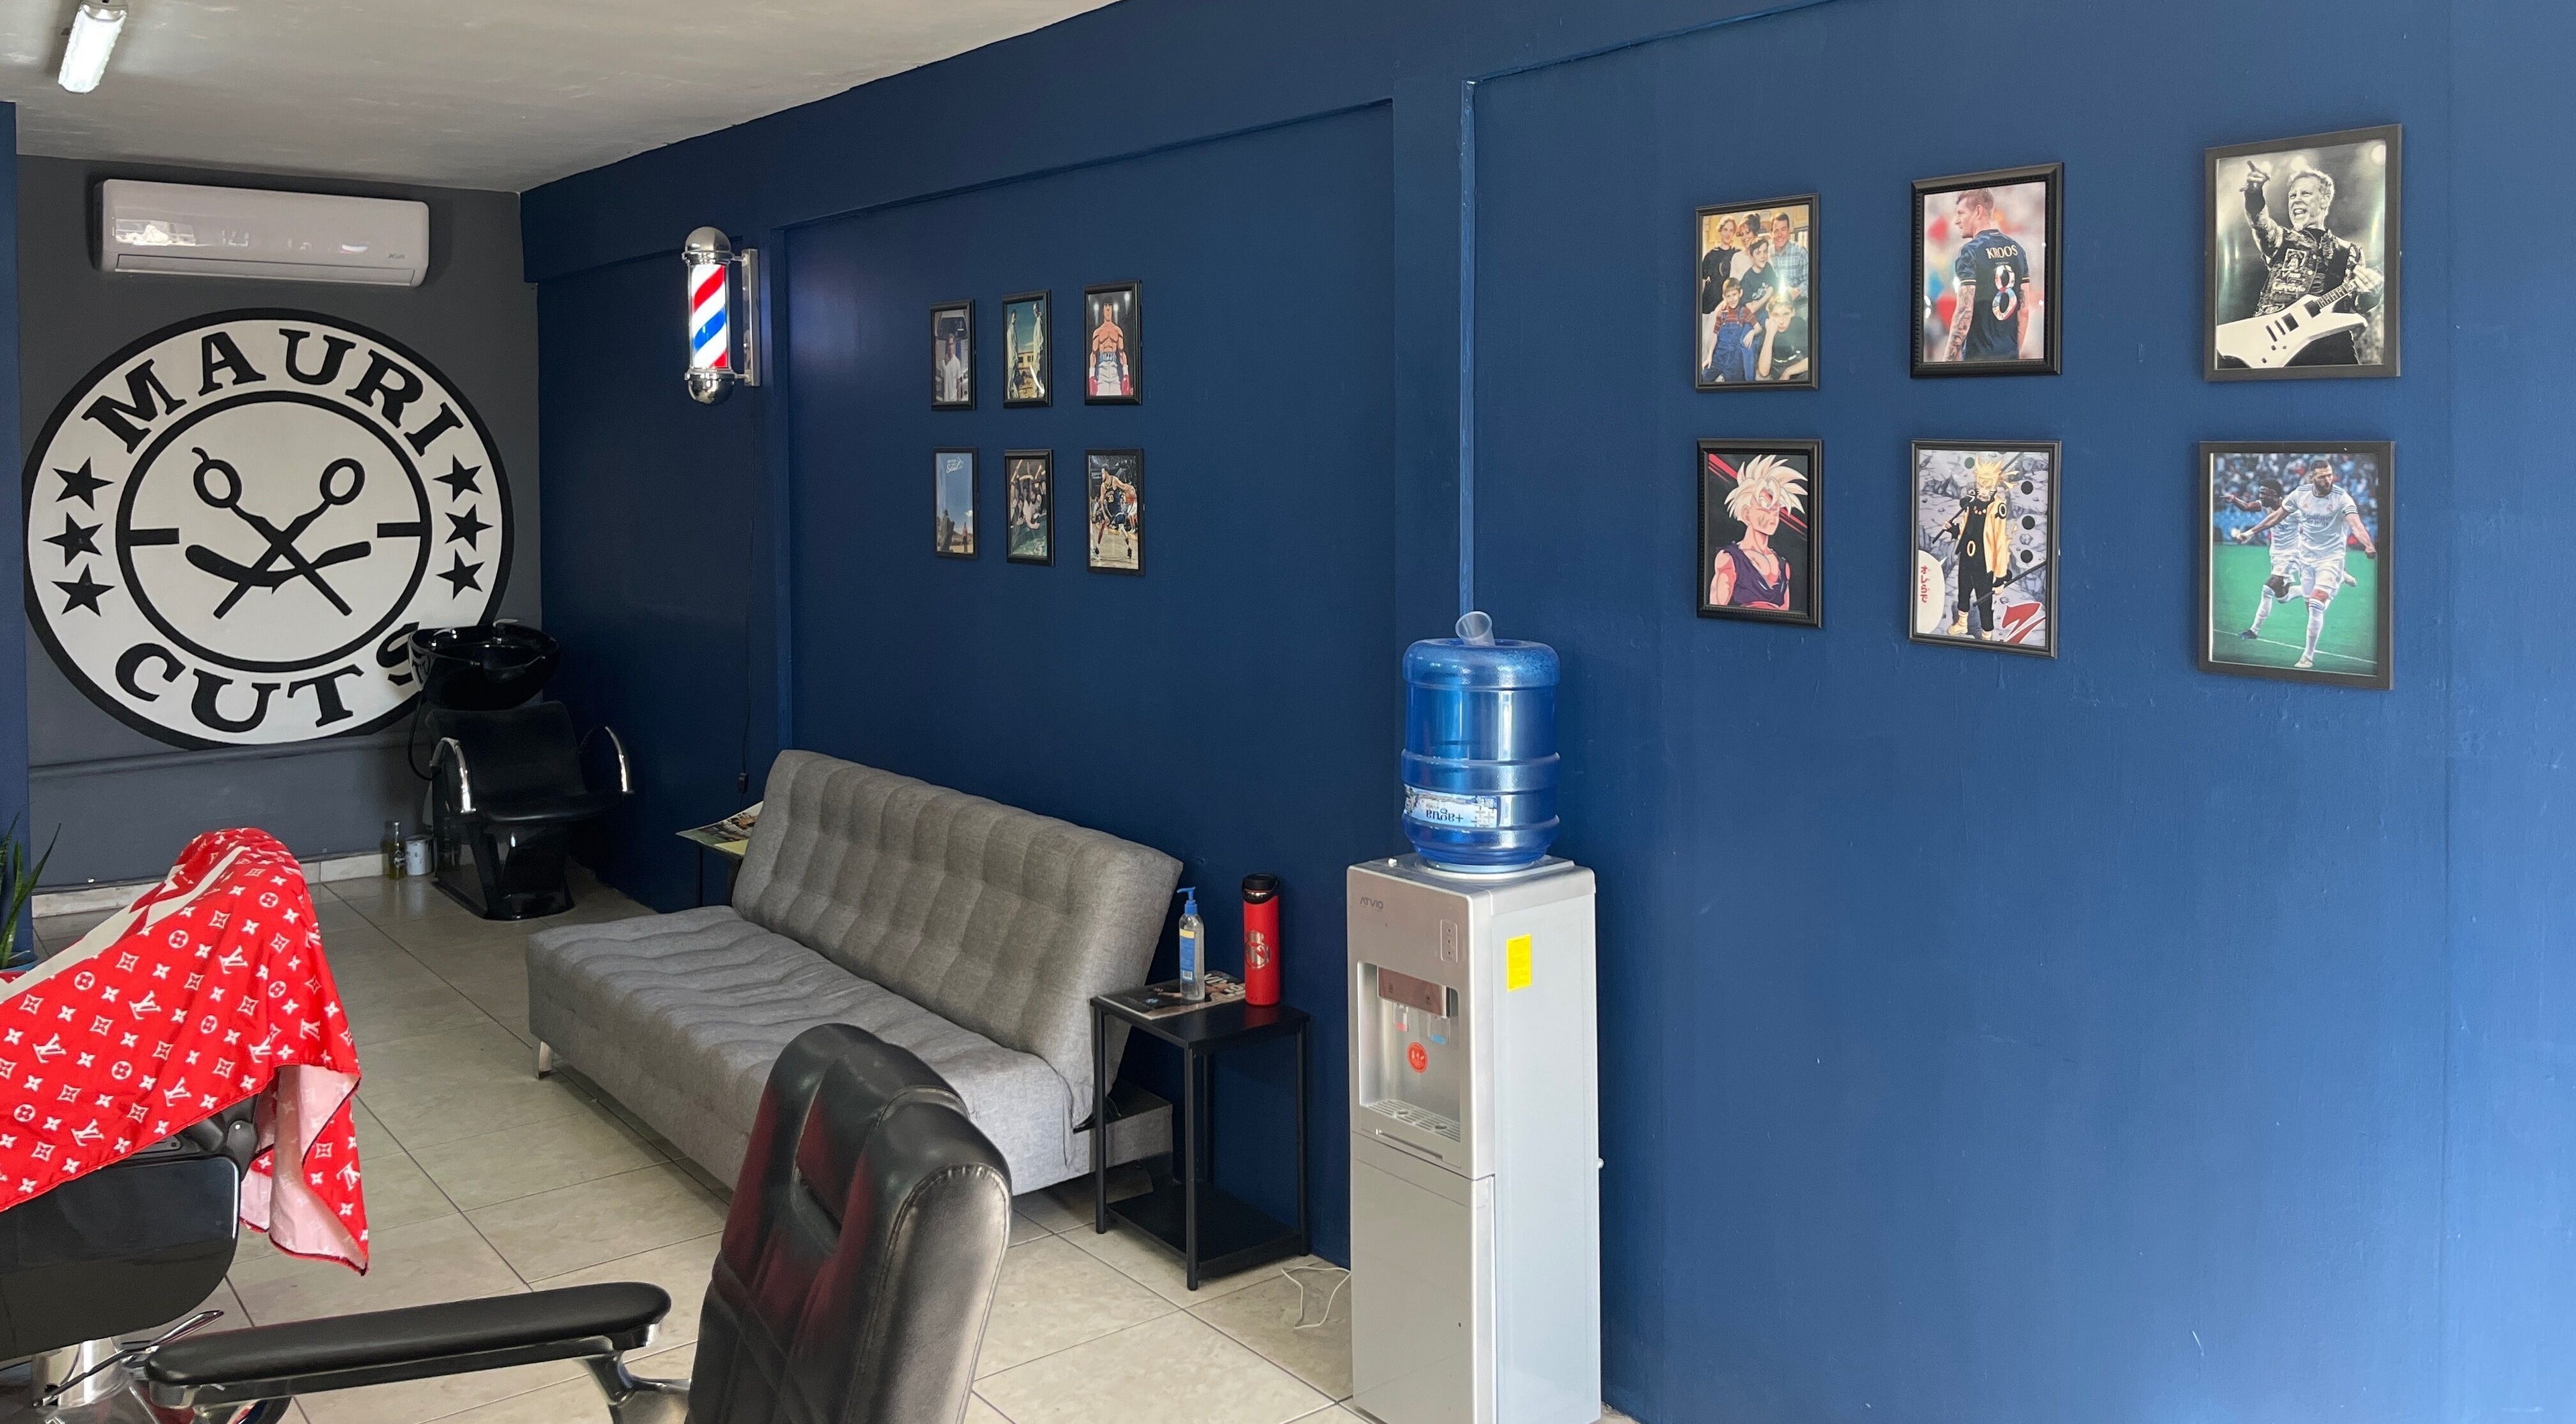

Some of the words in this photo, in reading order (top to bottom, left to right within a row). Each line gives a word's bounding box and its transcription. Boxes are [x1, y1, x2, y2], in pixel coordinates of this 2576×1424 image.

[1986, 245, 2018, 259] KROOS
[1992, 265, 2018, 320] 8
[81, 328, 464, 457] MAURI
[115, 622, 419, 733] CUTS
[1360, 896, 1383, 910] ATVIO
